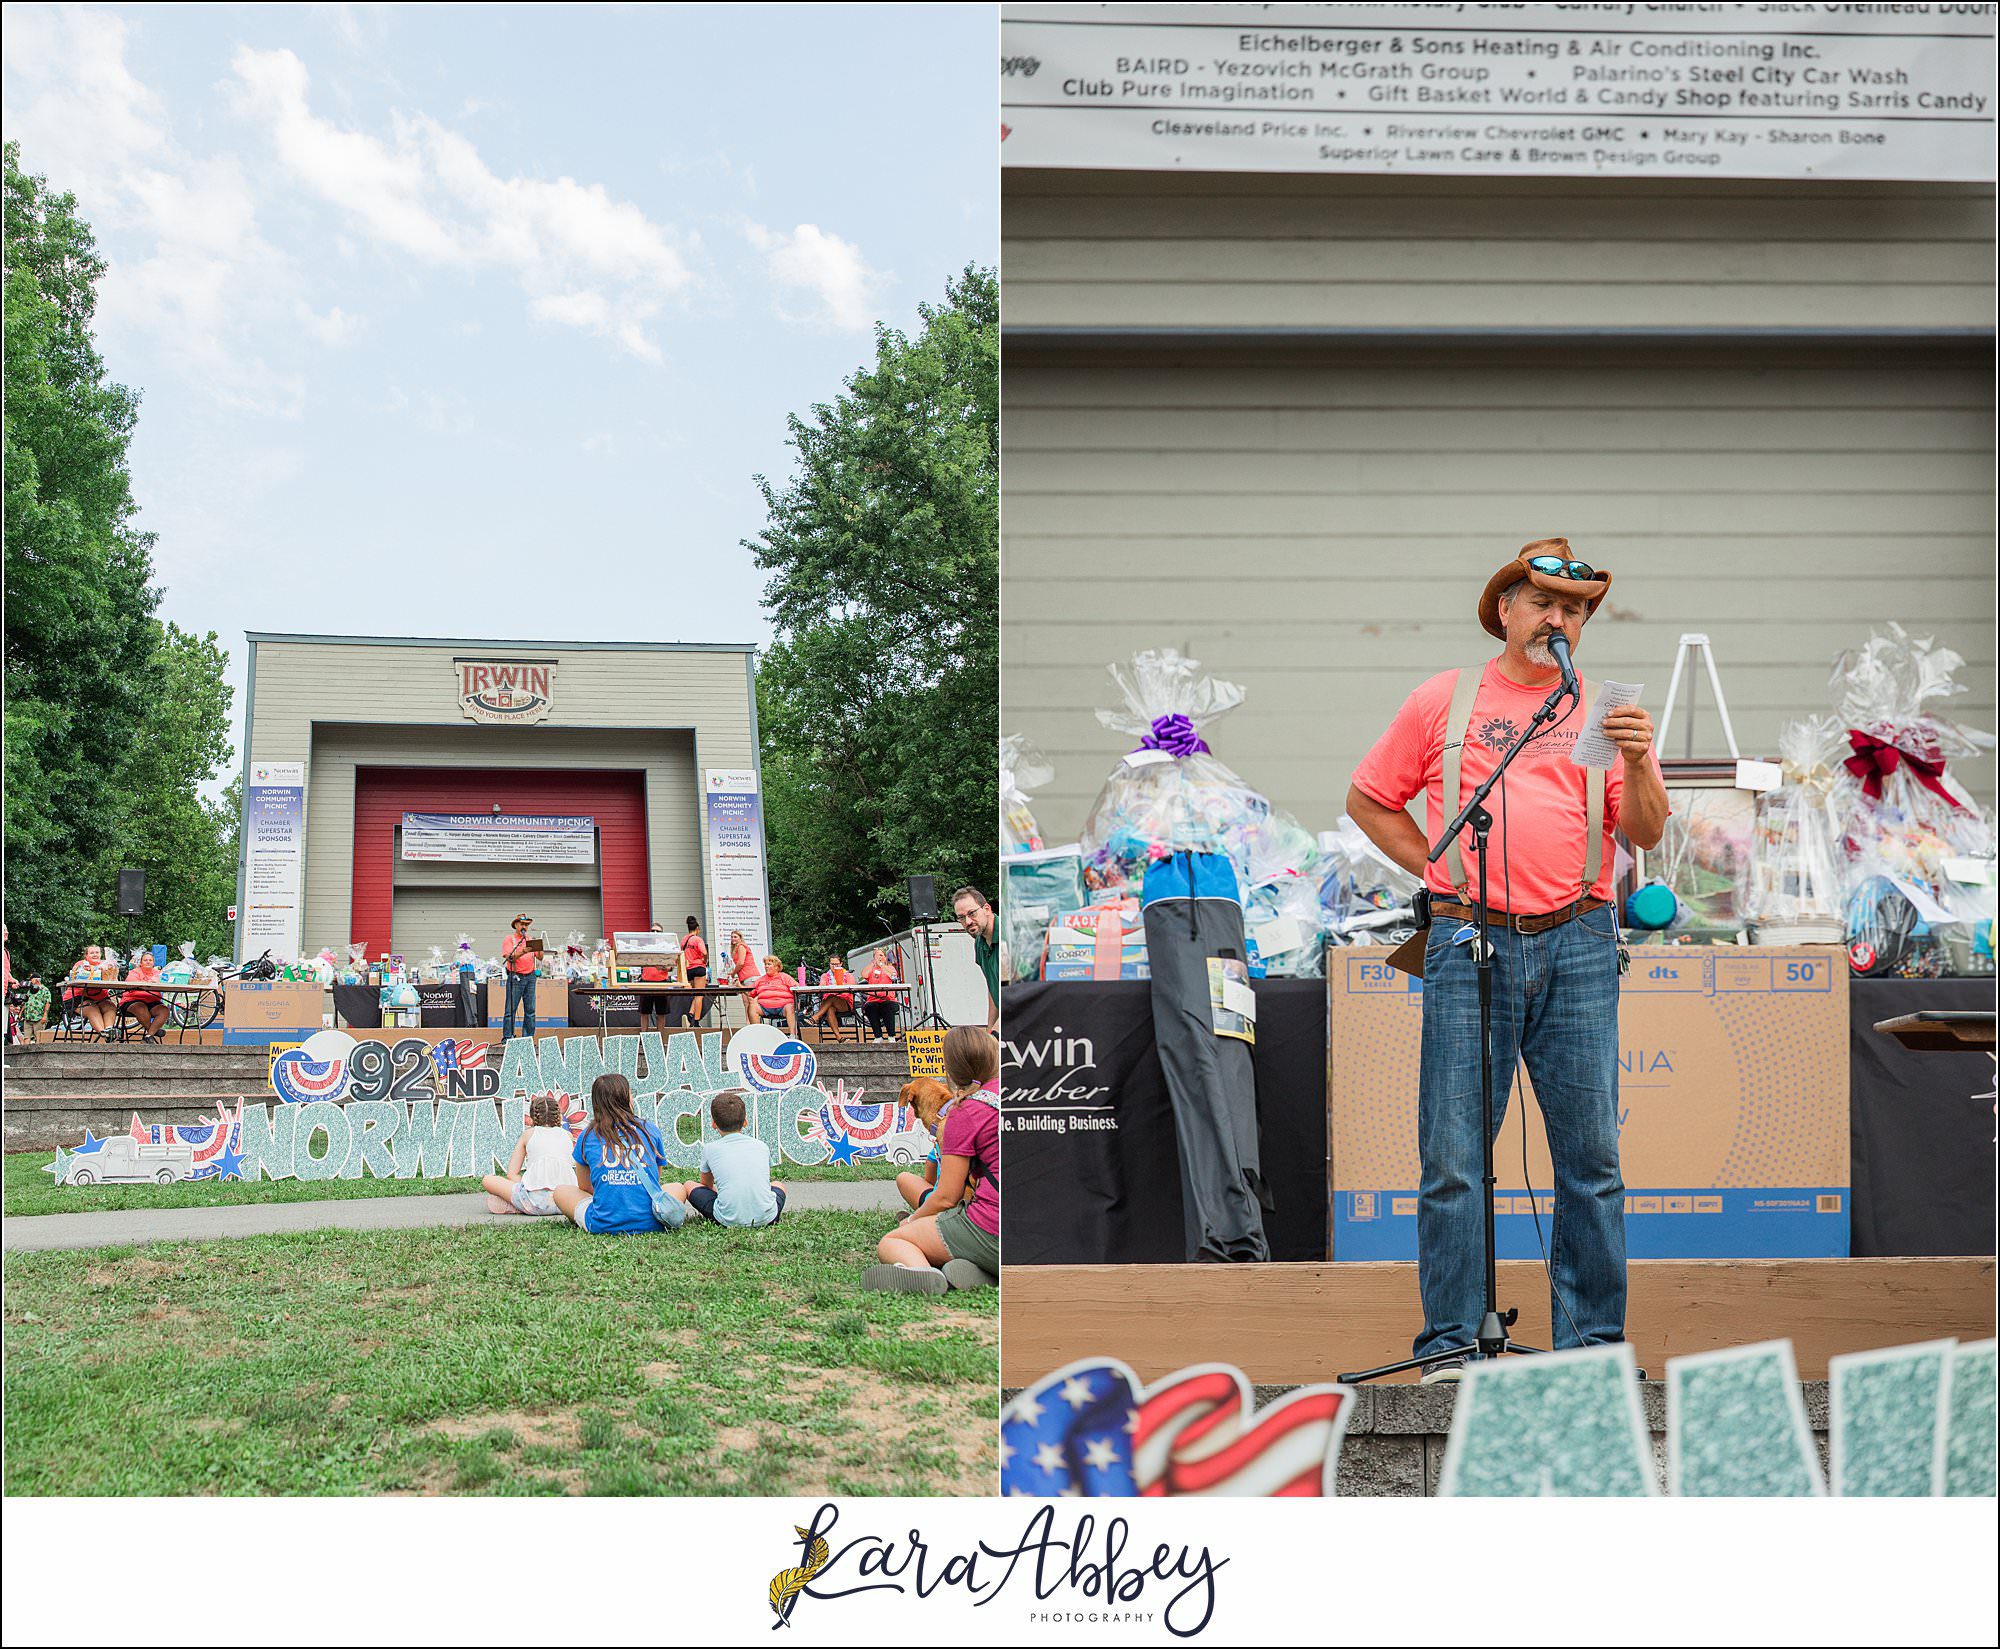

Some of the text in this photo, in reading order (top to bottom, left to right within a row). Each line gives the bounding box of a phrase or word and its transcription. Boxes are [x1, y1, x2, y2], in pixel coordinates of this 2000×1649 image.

[1239, 34, 1821, 61] Eichelberger & Sons Heating & Air Conditioning Inc.
[1117, 57, 1189, 74] BAIRD
[1213, 59, 1311, 77] Yezovich
[1320, 62, 1412, 79] McGrath
[1421, 63, 1489, 82] Group
[1573, 65, 1908, 87] Palarino's Steel City Car Wash
[1063, 79, 1314, 101] Club Pure Imagination
[1368, 85, 1987, 112] Gift Basket World & Candy Shop featuring Sarris Candy
[1151, 119, 1348, 138] Cleaveland Price Inc.
[1386, 124, 1625, 141] Riverview Chevrolet GMC
[1663, 128, 1708, 145] Mary
[1715, 129, 1748, 145] Kay
[1768, 129, 1832, 144] Sharon
[1319, 144, 1721, 166] Superior Lawn Care & Brown Design Group
[463, 665, 550, 699] IRWIN
[469, 704, 485, 715] FIND
[485, 712, 503, 720] YOUR
[526, 706, 544, 717] HERE
[450, 816, 591, 826] NORWIN COMMUNITY PICNIC
[1064, 916, 1098, 928] RACK
[1360, 965, 1395, 980] F30
[1648, 966, 1679, 979] dts
[423, 991, 453, 999] Norwin
[909, 1035, 931, 1044] Must
[909, 1046, 943, 1054] Presen
[498, 1031, 742, 1100] ANNUAL
[911, 1055, 944, 1064] To Win
[912, 1065, 939, 1074] Picnic
[1017, 1116, 1066, 1134] Building
[1069, 1115, 1118, 1131] Business.
[241, 1097, 526, 1182] NORWIN
